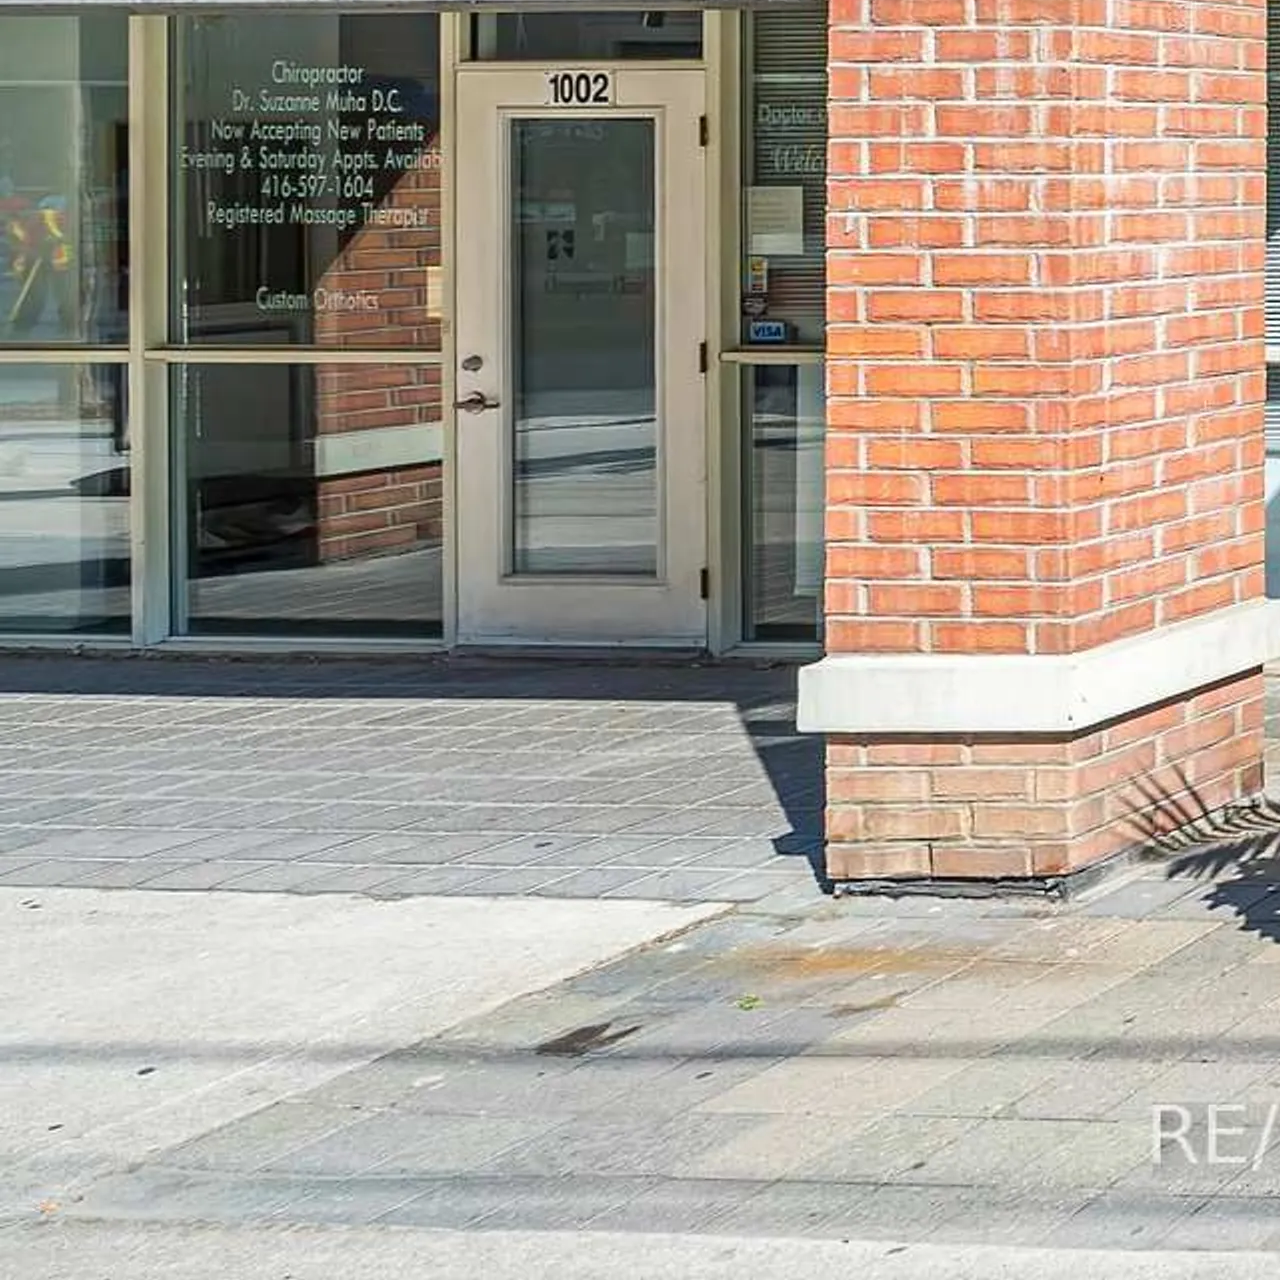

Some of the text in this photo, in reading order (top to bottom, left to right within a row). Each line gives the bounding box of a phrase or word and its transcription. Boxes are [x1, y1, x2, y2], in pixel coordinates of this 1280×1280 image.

[272, 60, 365, 87] Chiropractor
[232, 89, 402, 112] Dr. Suzanne Muha D.C.
[549, 73, 609, 104] 1002
[211, 119, 424, 146] Now Accepting New Patients
[180, 146, 234, 173] Evening
[240, 147, 255, 169] &
[259, 147, 325, 172] Saturday
[261, 176, 374, 198] 416-597-1604
[207, 202, 285, 229] Registered
[290, 204, 356, 229] Massage
[256, 286, 379, 311] Custom Orthotics
[753, 324, 783, 339] VISA
